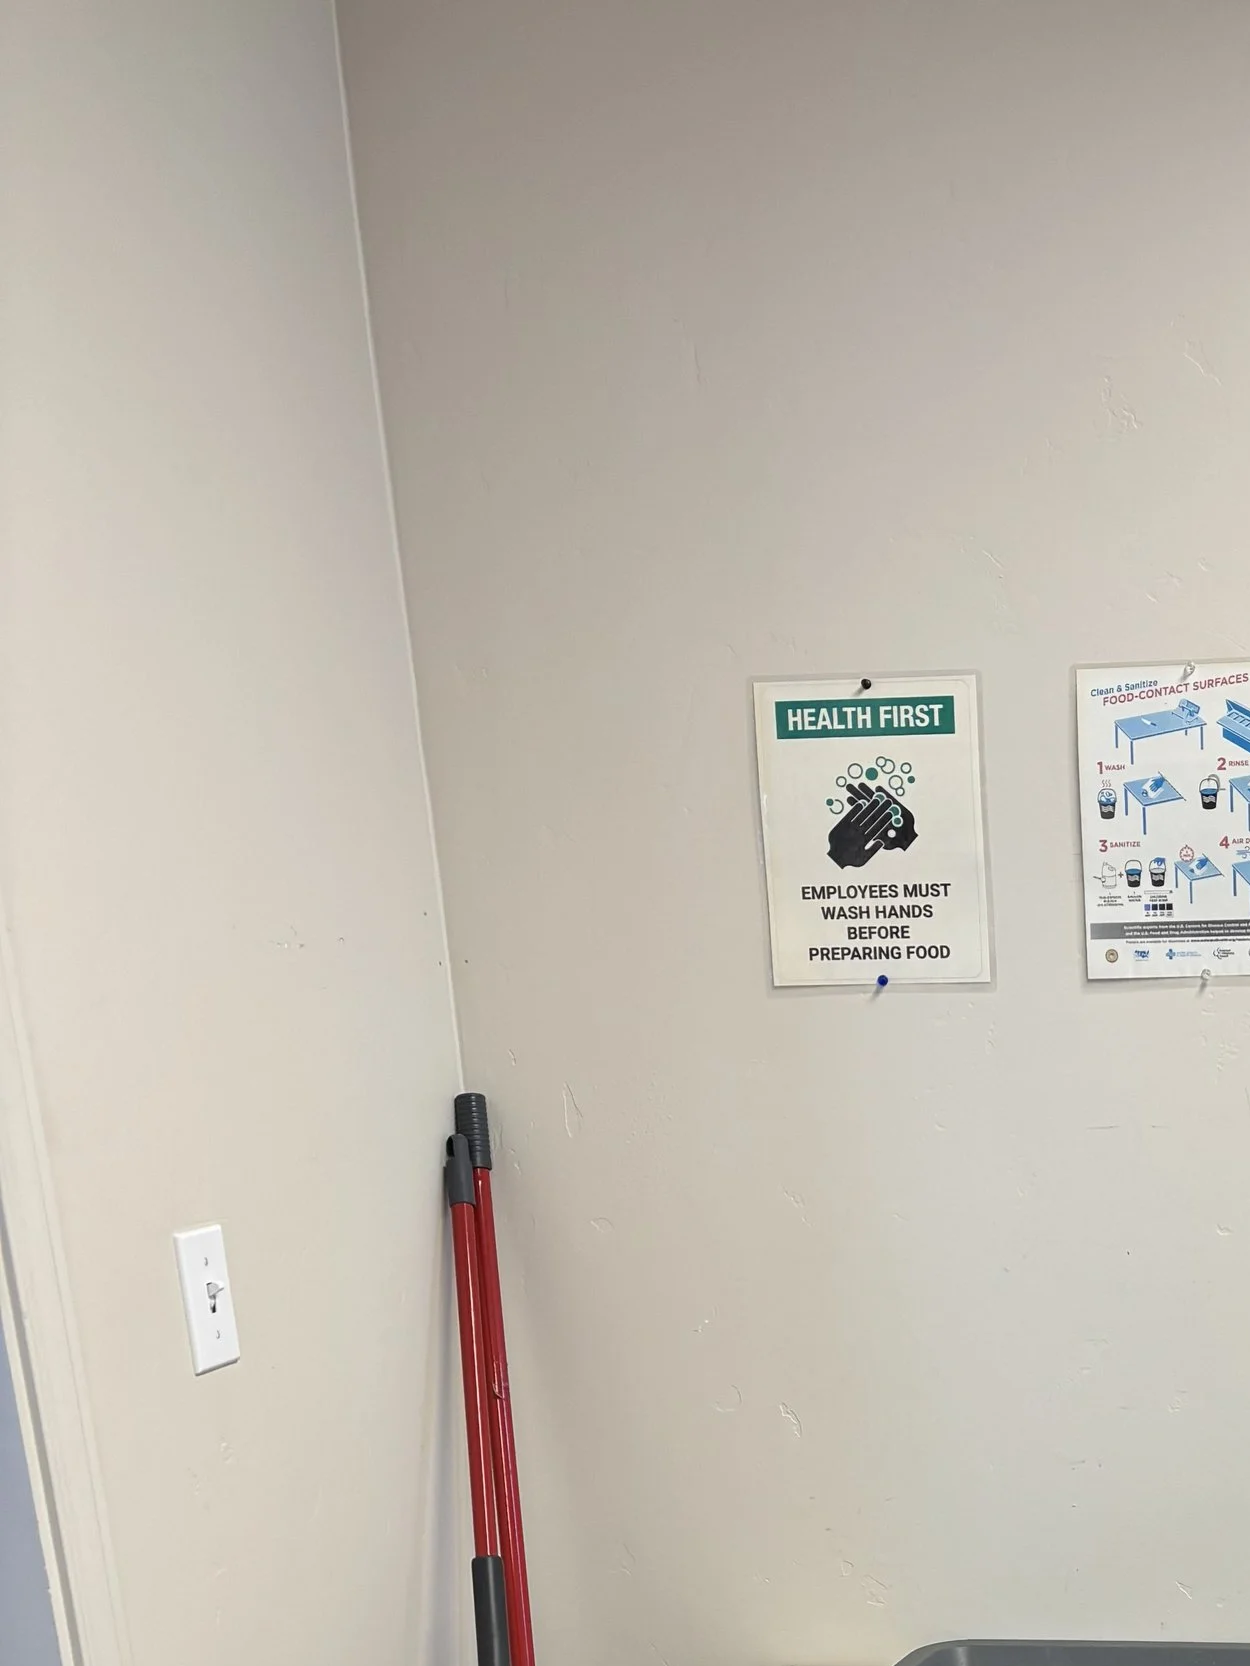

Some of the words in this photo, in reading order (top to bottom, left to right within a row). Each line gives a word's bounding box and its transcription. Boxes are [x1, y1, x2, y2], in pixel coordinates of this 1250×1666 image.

[1090, 687, 1114, 697] Clean
[1124, 679, 1158, 691] Sanitize
[1103, 683, 1190, 706] FOOD-CONTACT
[1193, 673, 1249, 691] SURFACES
[787, 707, 872, 731] HEALTH
[879, 704, 943, 728] FIRST
[1097, 761, 1103, 774] 1
[1217, 757, 1227, 770] 2
[1099, 840, 1108, 852] 3
[1219, 836, 1229, 848] 4
[801, 885, 899, 900] EMPLOYEES
[903, 883, 951, 898] MUST
[821, 905, 871, 920] WASH
[875, 904, 933, 919] HANDS
[847, 926, 910, 940] BEFORE
[808, 947, 901, 962] PREPARING
[906, 945, 950, 959] FOOD
